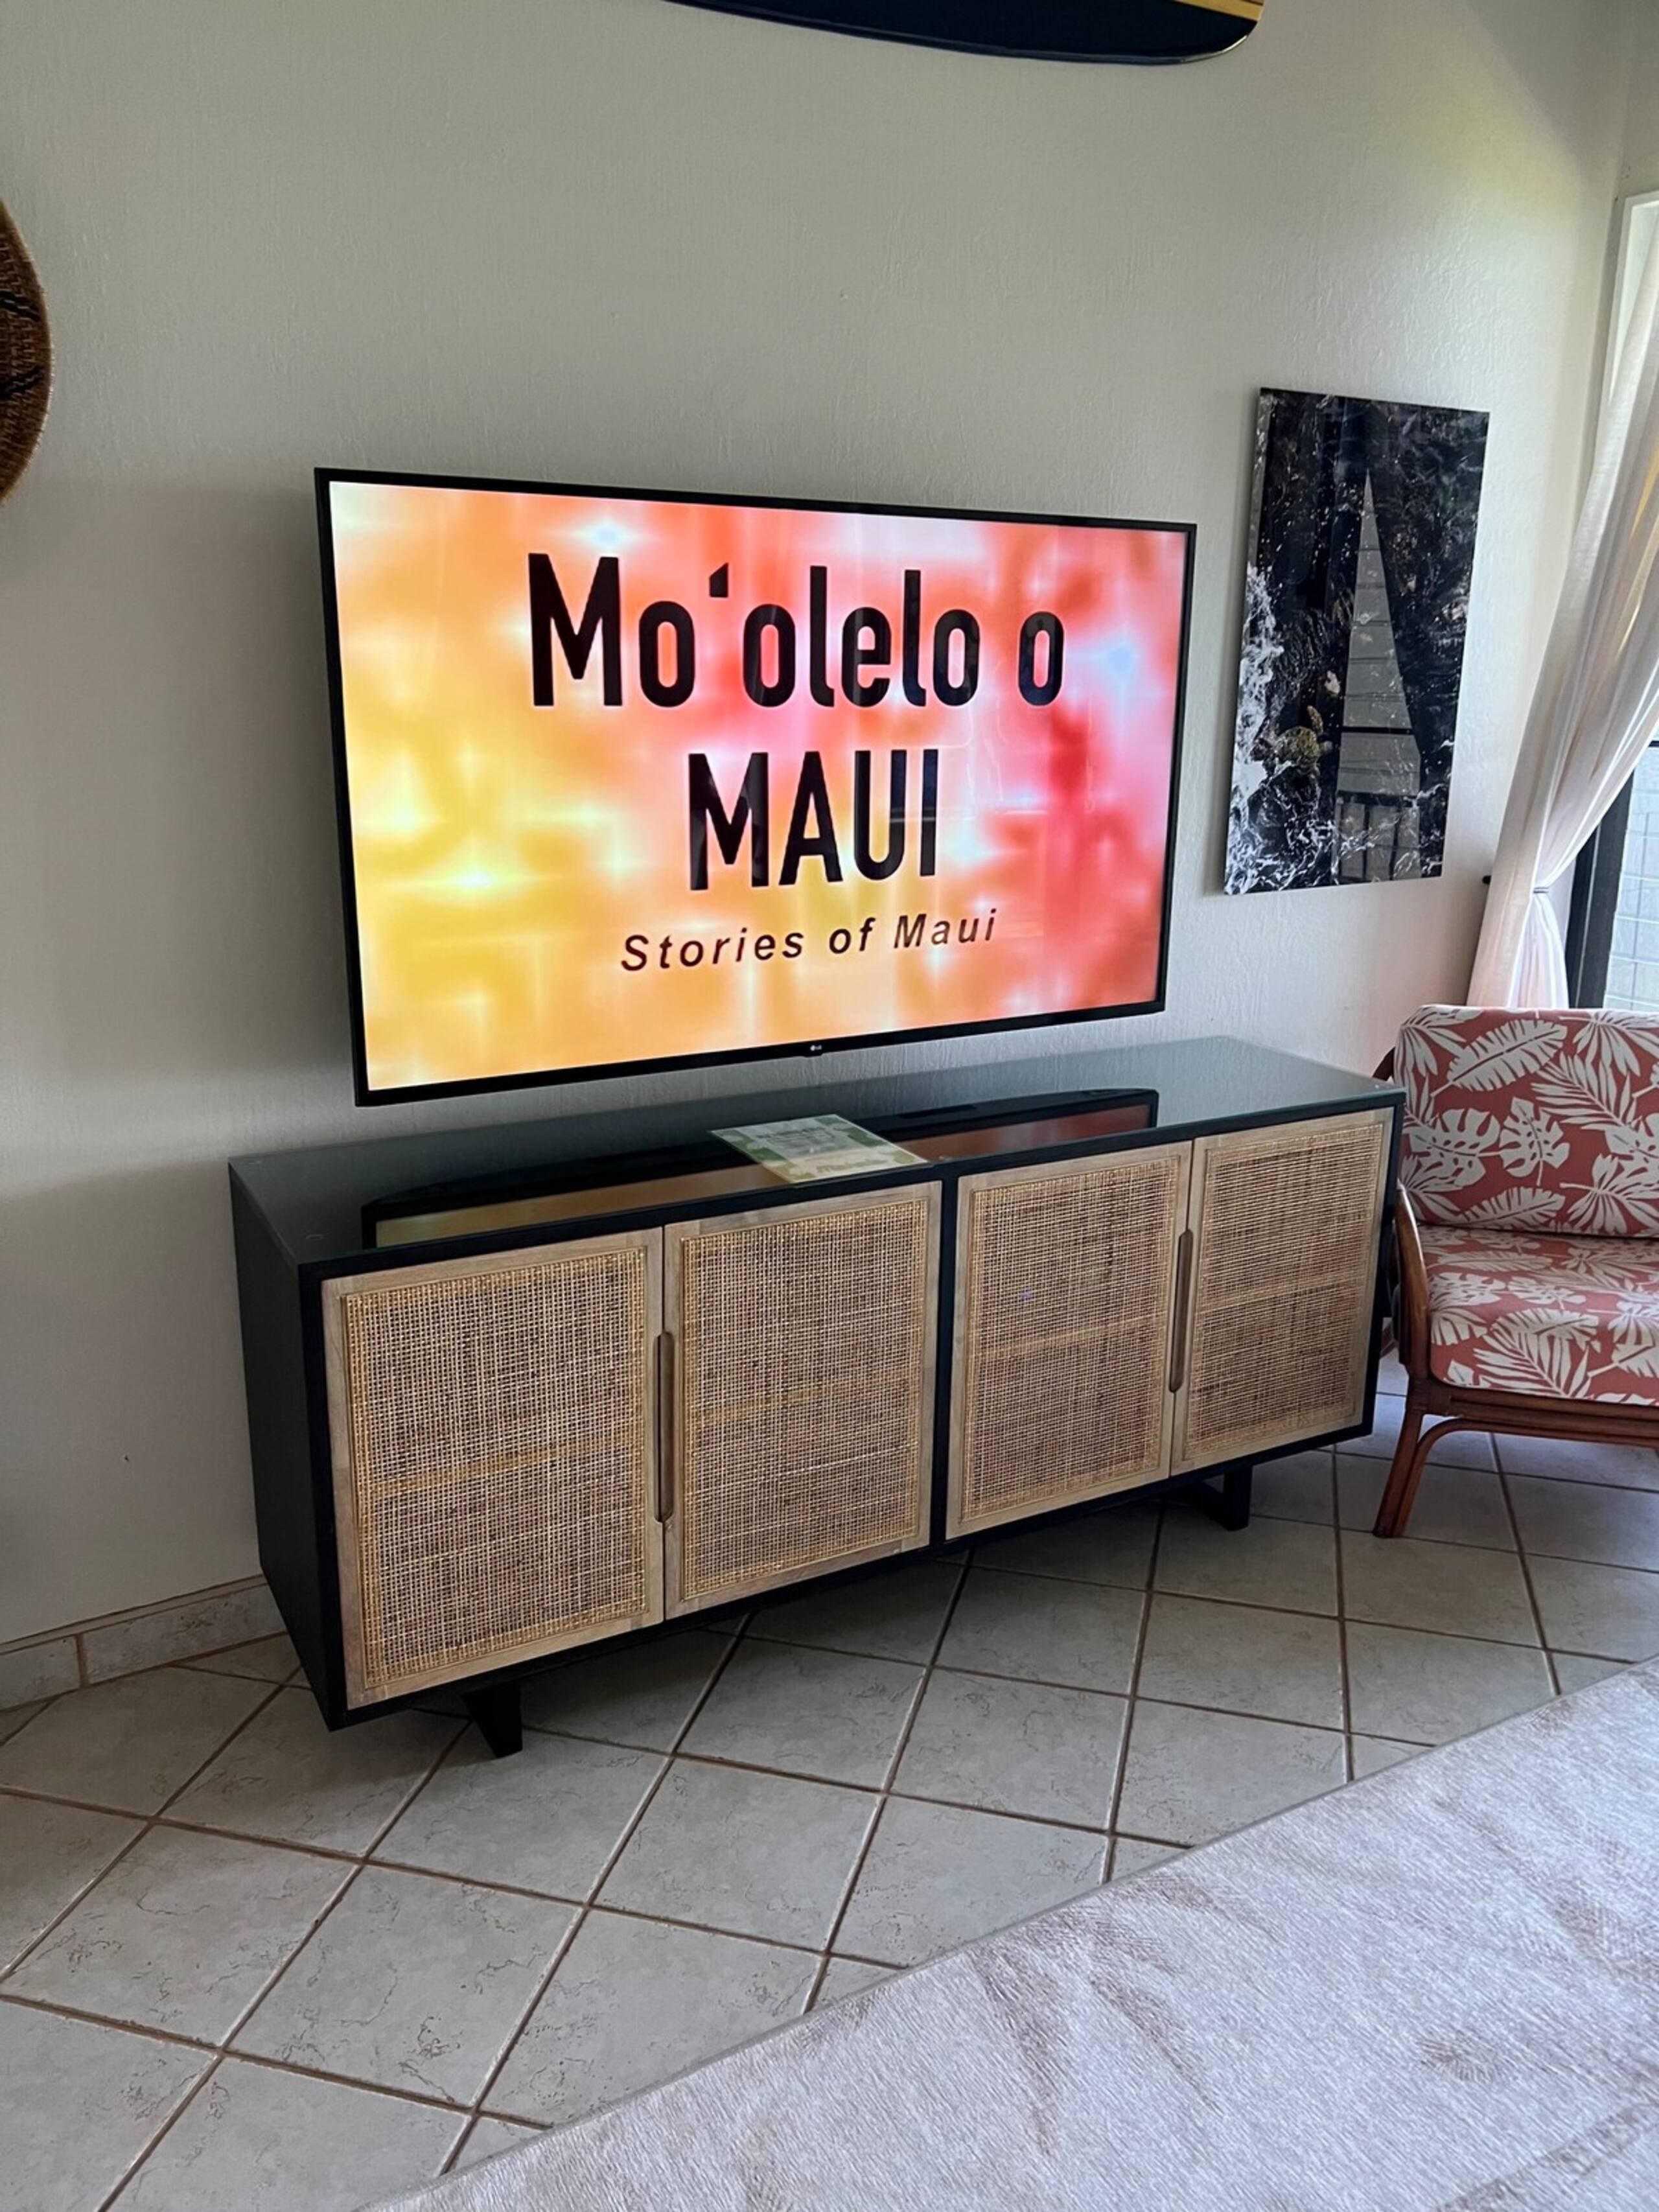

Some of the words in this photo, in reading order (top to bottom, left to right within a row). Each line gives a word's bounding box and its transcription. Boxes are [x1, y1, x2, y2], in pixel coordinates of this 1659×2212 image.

[1017, 611, 1065, 706] o
[688, 748, 939, 891] MAUI
[620, 926, 805, 972] Stories
[828, 916, 877, 955] of
[893, 907, 997, 949] Maui
